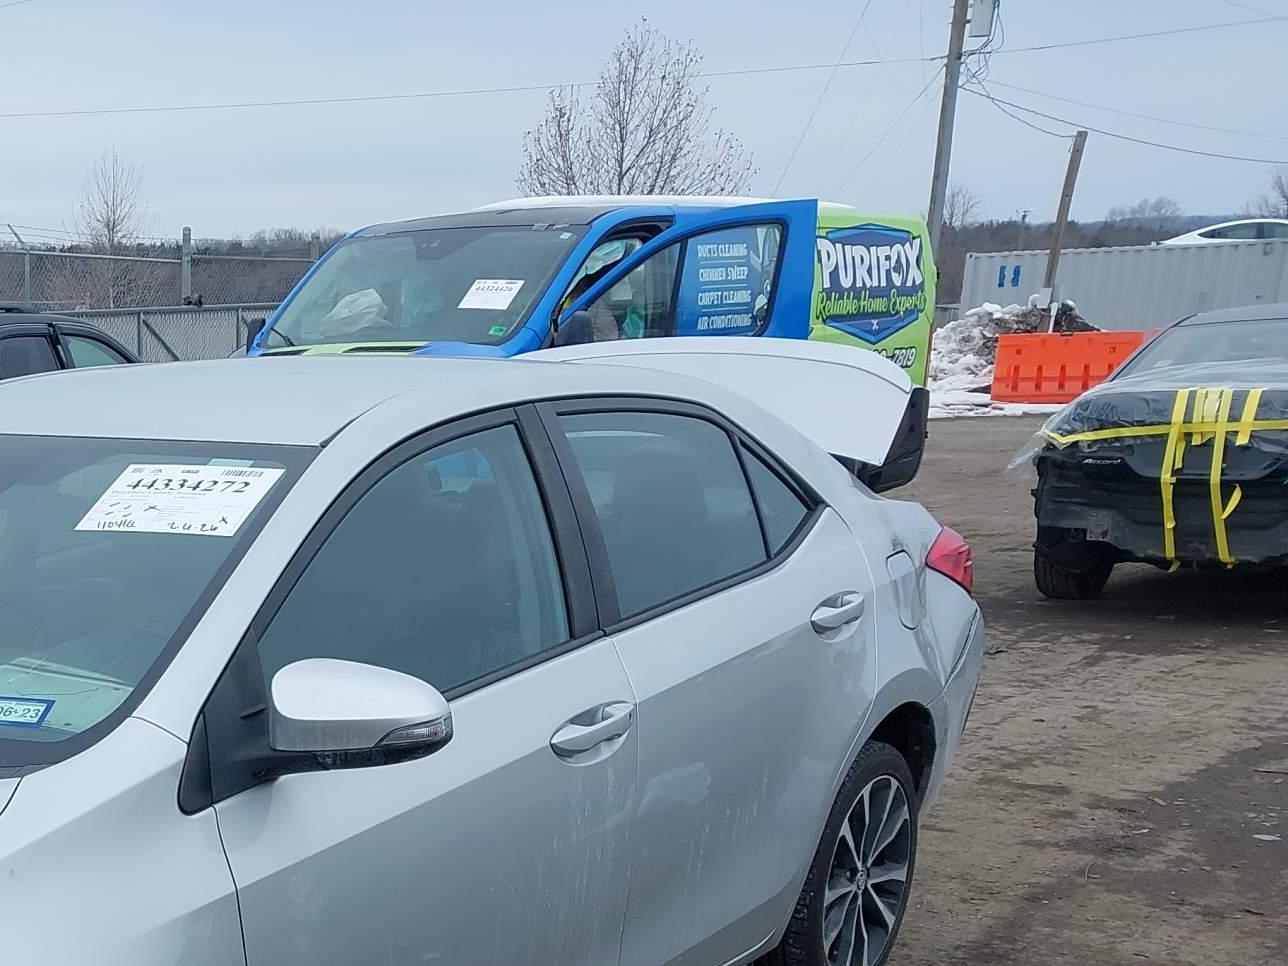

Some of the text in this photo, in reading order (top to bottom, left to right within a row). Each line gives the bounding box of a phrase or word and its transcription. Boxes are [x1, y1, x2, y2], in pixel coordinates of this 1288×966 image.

[718, 243, 748, 257] CLEANING
[816, 237, 923, 288] PURIFOX
[727, 265, 748, 280] SWEEP
[698, 290, 752, 305] CARPET CLEANING
[816, 288, 926, 322] Reliable Home Experts
[697, 314, 753, 330] AIR CONDITIONING
[126, 478, 251, 493] 44334272
